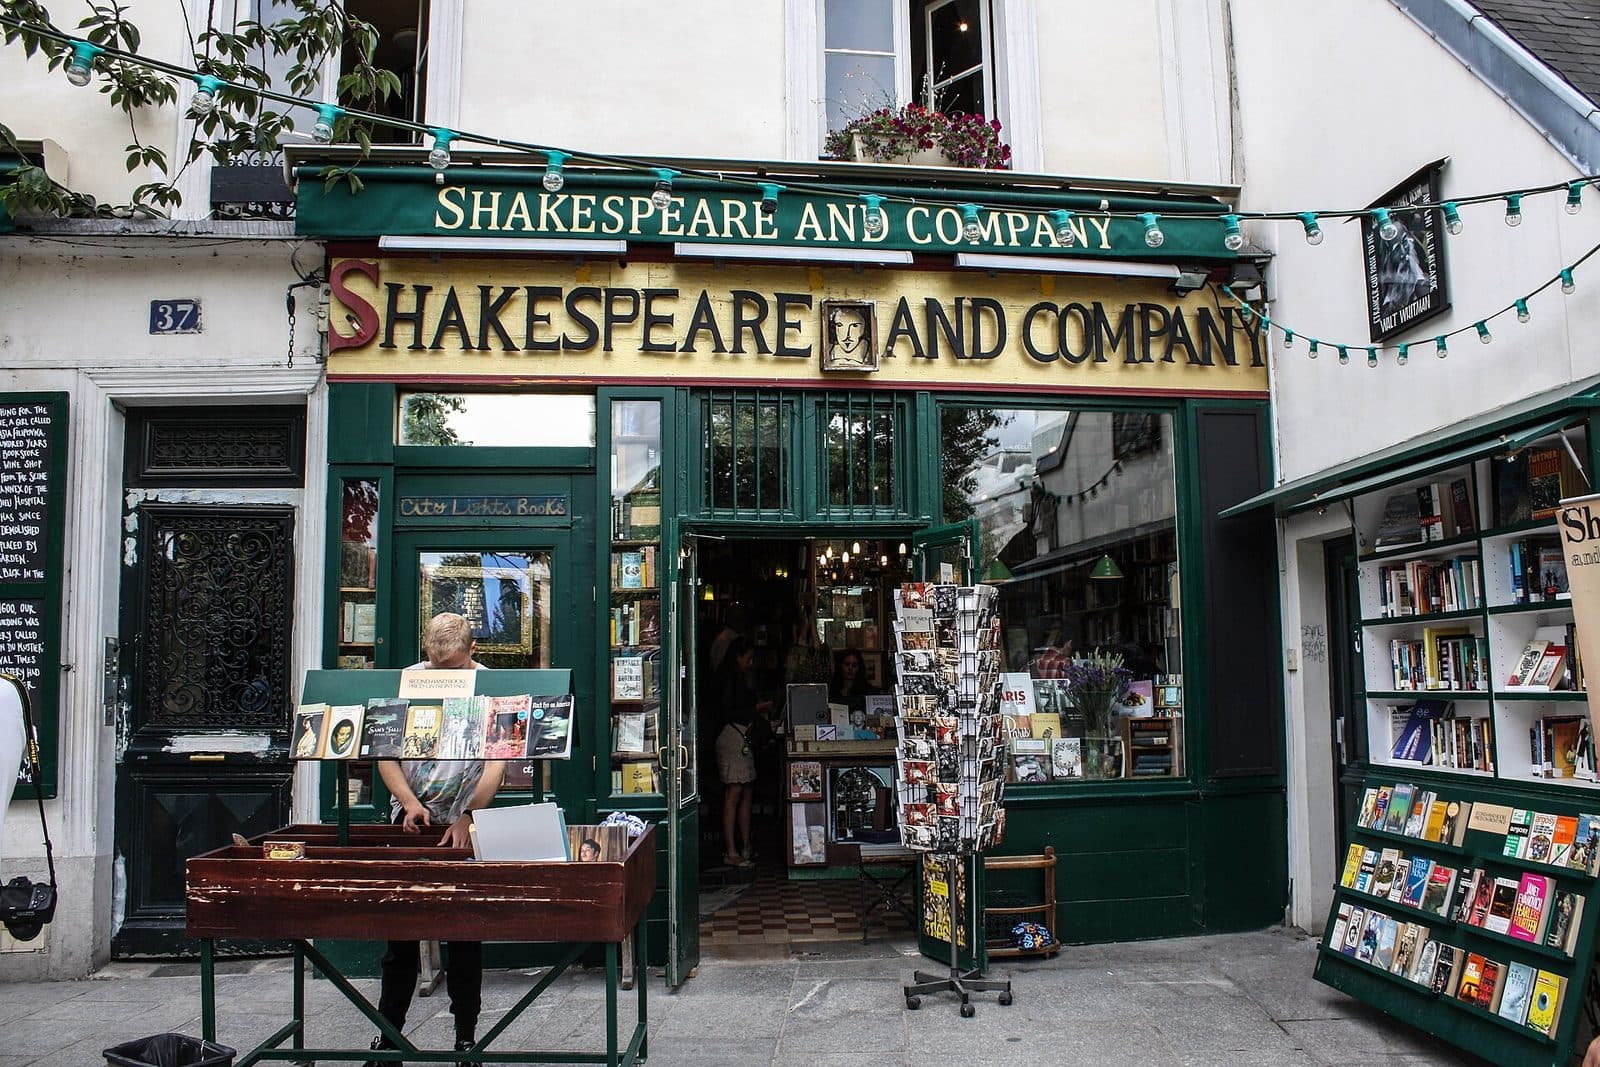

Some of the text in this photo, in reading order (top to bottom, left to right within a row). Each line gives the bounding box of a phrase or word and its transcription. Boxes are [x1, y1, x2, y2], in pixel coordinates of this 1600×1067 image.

[435, 186, 1112, 252] SHAKESPEARE AND COMPANY
[157, 304, 194, 330] 37
[328, 258, 1266, 367] SHAKESPEARE AND COMPANY
[1379, 293, 1432, 333] WALT WHITMAN
[34, 406, 48, 415] THE
[31, 416, 52, 426] CALLED
[26, 439, 48, 449] YEARS
[3, 449, 40, 460] BOOKSTORE
[3, 459, 43, 470] WINE SHOP
[24, 485, 33, 495] OF
[35, 485, 48, 495] THE
[14, 495, 46, 510] HOSPITAL
[1, 511, 42, 522] HAS SINCE
[1, 525, 40, 536] DEMOLISHED
[26, 540, 37, 554] BY
[24, 568, 31, 578] IN
[32, 569, 45, 579] THE
[20, 603, 37, 615] OUR
[24, 617, 40, 627] WAS
[15, 630, 38, 640] CALLED
[14, 654, 37, 665] TIMES
[27, 667, 41, 678] HAD
[1001, 690, 1026, 702] ARIS
[1526, 881, 1540, 898] JANET
[1515, 903, 1541, 921] FEARLESS
[1512, 915, 1537, 936] FOURTEEN
